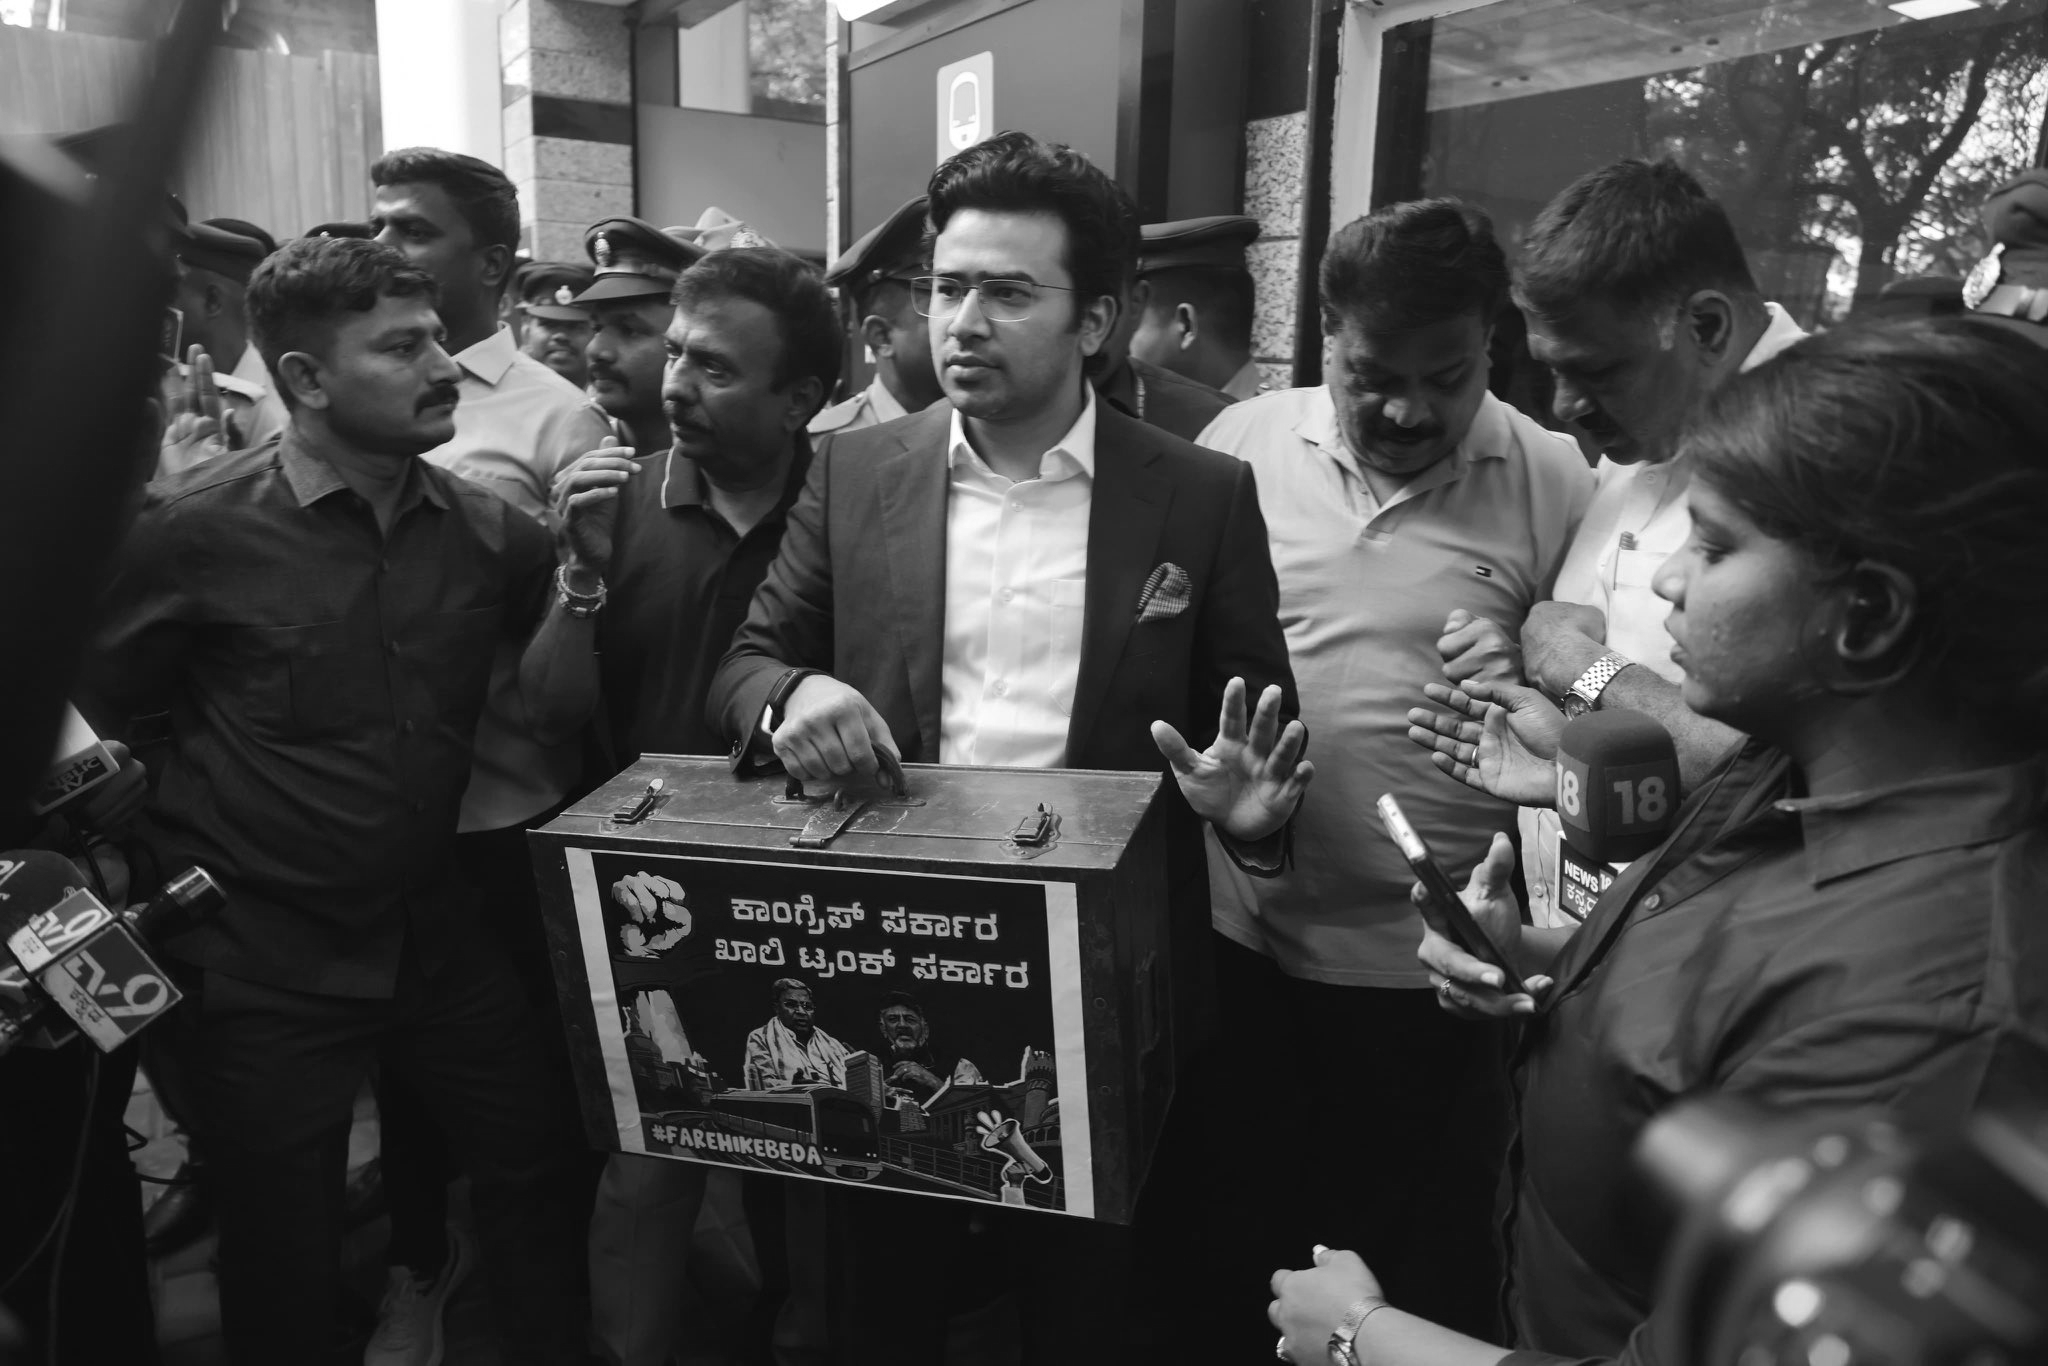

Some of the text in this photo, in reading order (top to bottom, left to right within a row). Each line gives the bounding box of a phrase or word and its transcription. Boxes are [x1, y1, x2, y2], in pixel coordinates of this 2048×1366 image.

[1556, 762, 1580, 816] 18
[1613, 776, 1668, 825] 18
[1564, 859, 1599, 893] NEWS
[28, 908, 104, 948] TV9
[730, 894, 999, 941] ಕಾಂಗ್ರೆಸ್ ಸರ್ಕಾರ
[63, 950, 169, 1018] TV9
[715, 937, 1029, 989] ಖಾಲಿ ಟ್ರಂಕ್ ಸರ್ಕಾರ
[652, 1124, 822, 1166] #FAREHIKEBEDA
